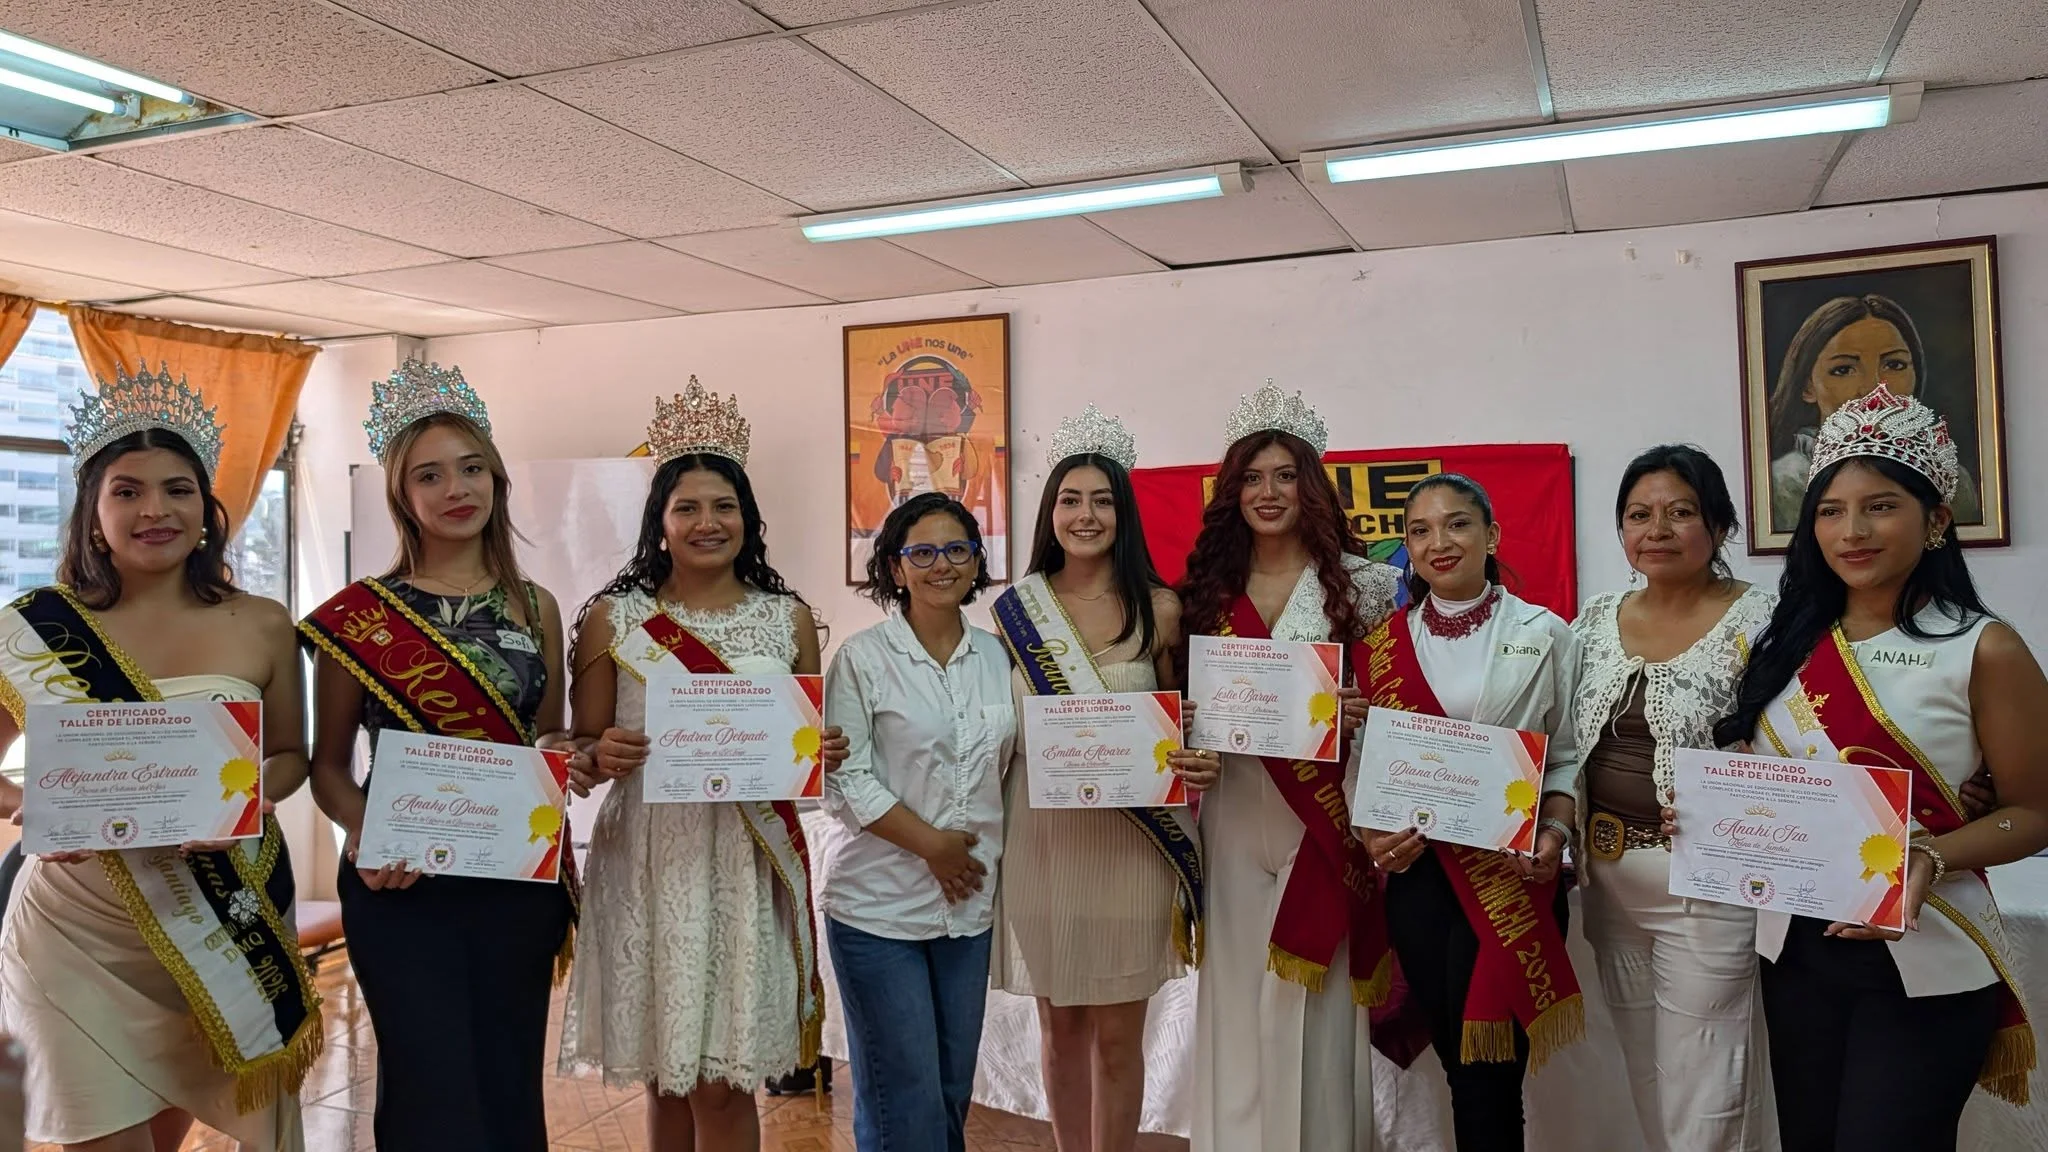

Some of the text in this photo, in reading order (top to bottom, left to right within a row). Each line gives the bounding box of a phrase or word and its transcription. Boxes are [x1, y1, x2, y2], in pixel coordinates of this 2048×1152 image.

[896, 337, 923, 354] UNE
[925, 338, 946, 348] nos
[1221, 644, 1272, 652] CERTIFICADO
[1244, 652, 1289, 660] LIDERAZGO
[1501, 643, 1541, 657] Diana
[1060, 698, 1114, 706] CERTIFICADO
[1212, 686, 1279, 704] Leslie Baraja
[86, 708, 167, 718] CERTIFICADO
[1044, 706, 1072, 714] TALLER
[59, 716, 192, 728] TALLER DE LIDERAZGO
[1410, 716, 1471, 732] CERTIFICADO
[659, 727, 769, 748] Andrea Delgado
[1390, 720, 1422, 731] TALLER
[1424, 725, 1438, 734] DE
[1438, 728, 1490, 742] LIDERAZGO
[404, 747, 514, 767] TALLER DE LIDERAZGO
[428, 742, 494, 756] CERTIFICADO
[1042, 744, 1082, 760] Emilia
[1388, 760, 1481, 787] Diana Carrión
[1728, 760, 1807, 775] CERTIFICADO
[39, 763, 200, 790] Alejandra Estrada
[1704, 766, 1832, 787] TALLER DE LIDERAZGO
[392, 794, 500, 817] Anahy Dávila
[1712, 818, 1772, 841] Anahi
[221, 931, 265, 963] DMQ
[1516, 940, 1557, 1011] 2026
